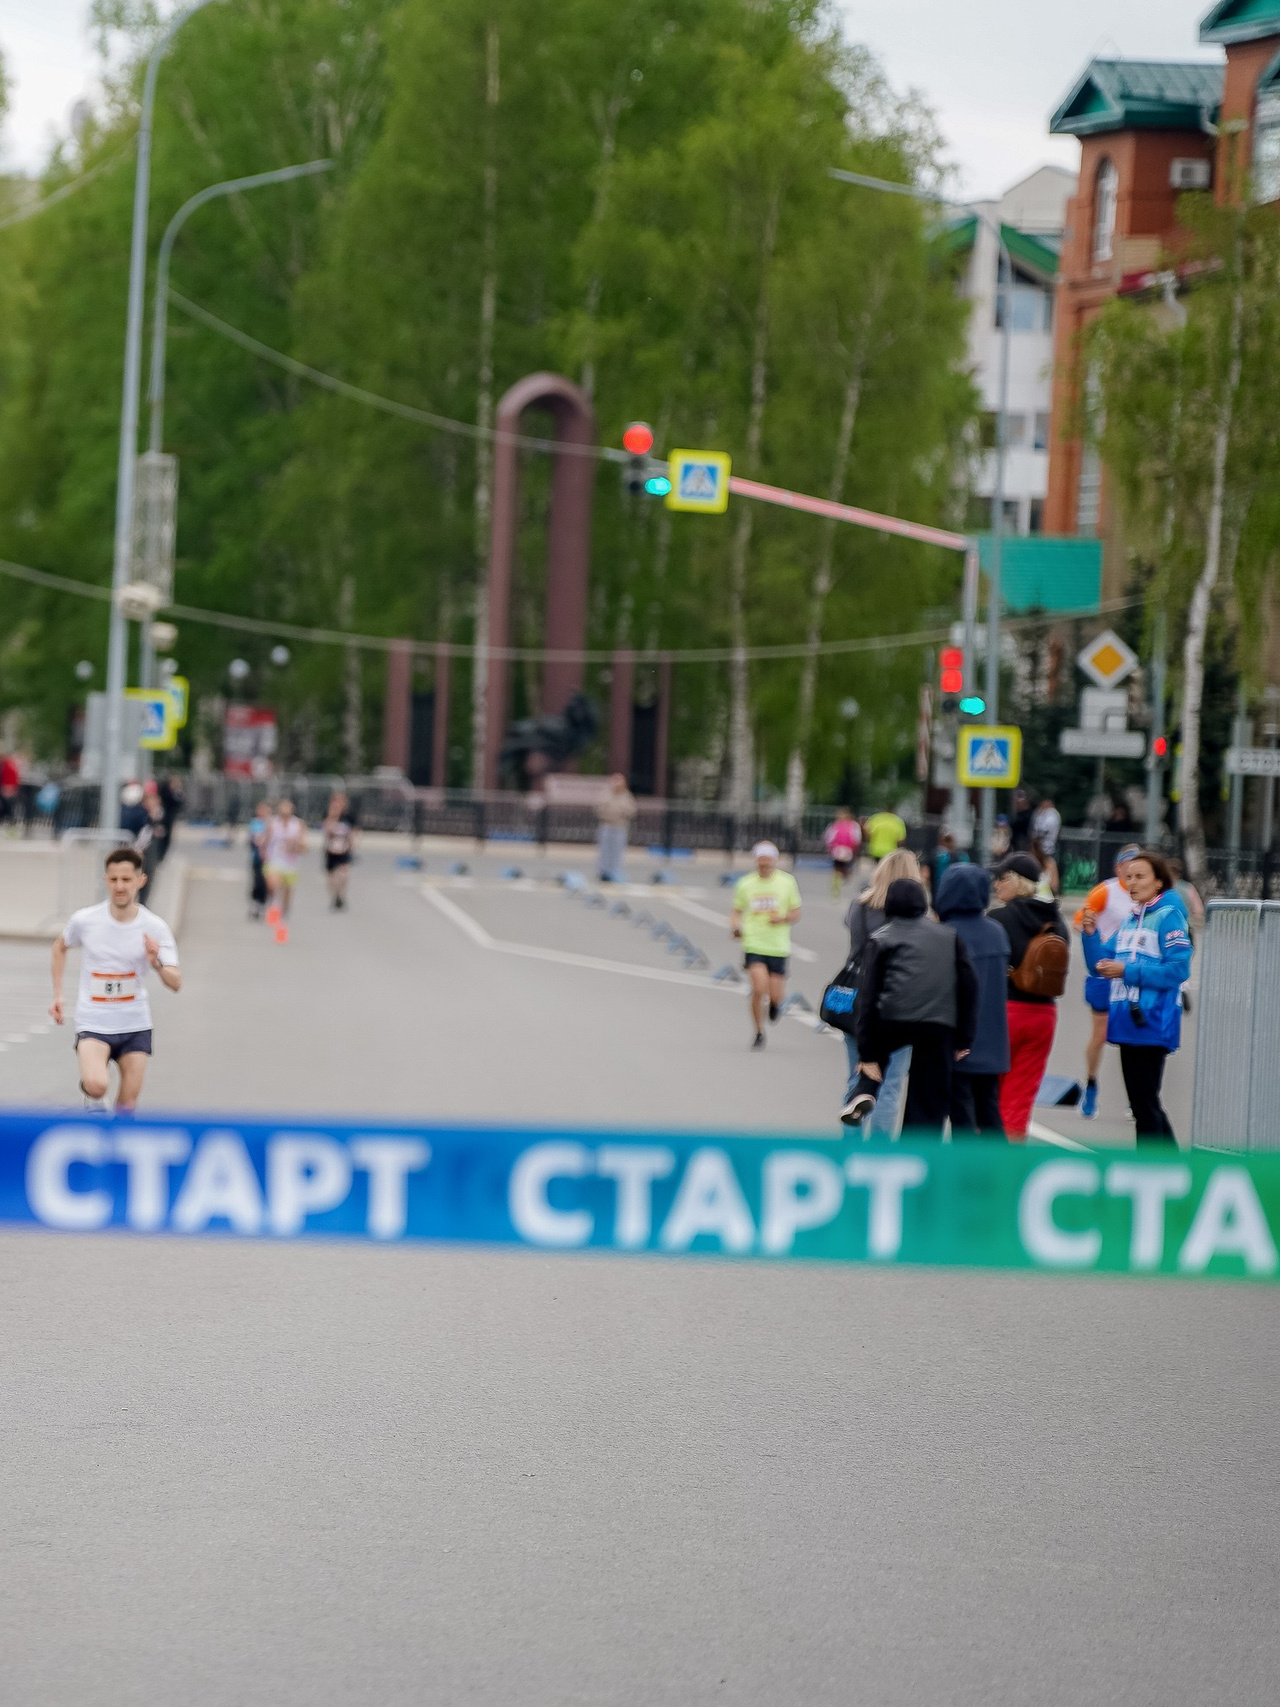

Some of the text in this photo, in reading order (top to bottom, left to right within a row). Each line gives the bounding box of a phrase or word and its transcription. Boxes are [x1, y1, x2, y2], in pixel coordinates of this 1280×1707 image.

[25, 1124, 431, 1240] СТАРТ
[508, 1141, 927, 1259] СТАРТ
[1019, 1158, 1279, 1274] СТА
